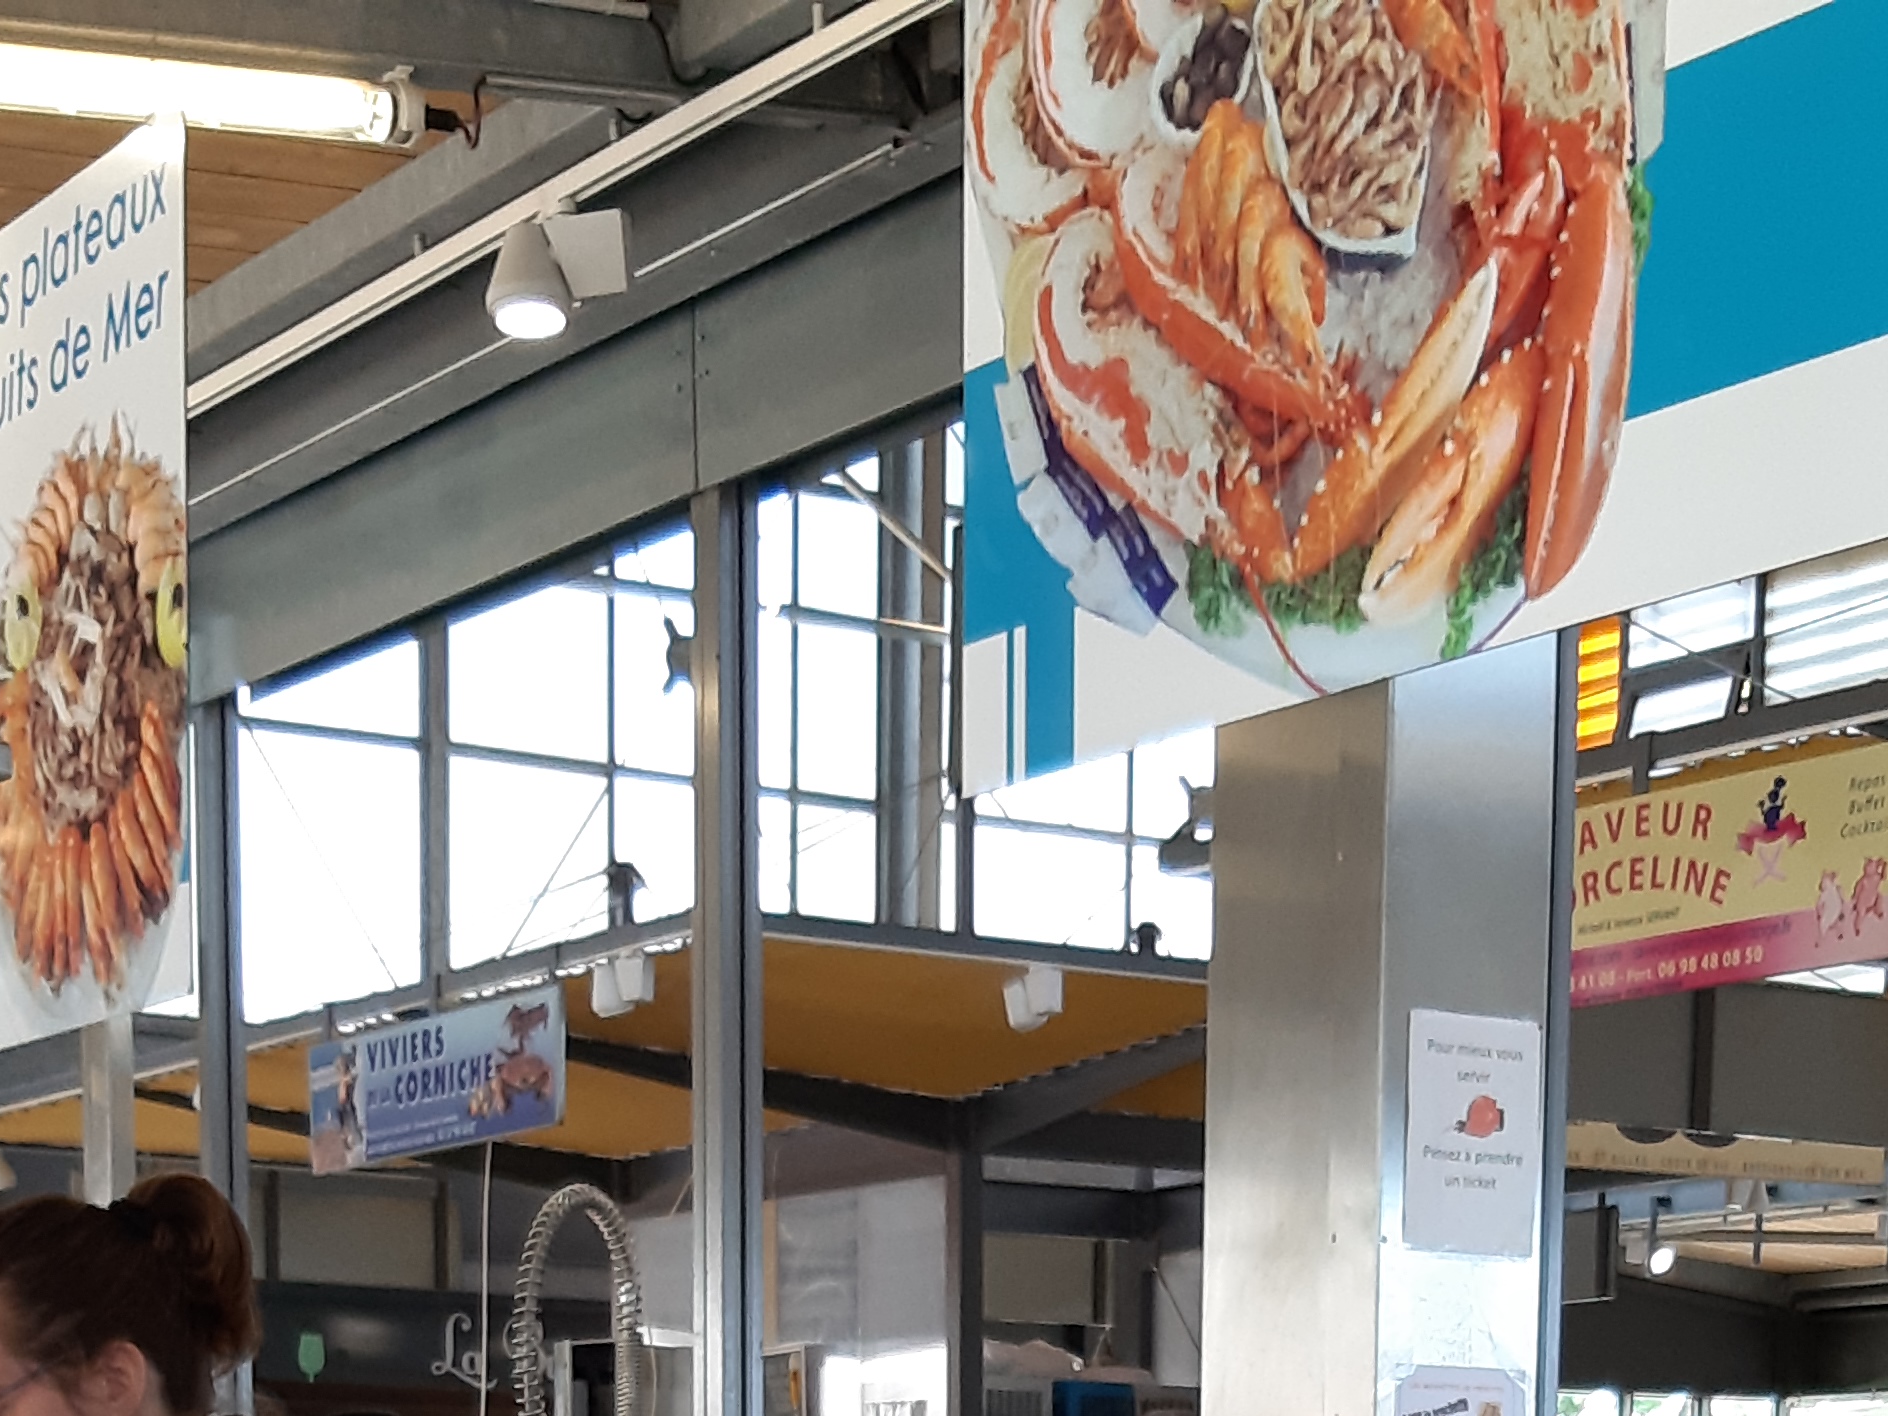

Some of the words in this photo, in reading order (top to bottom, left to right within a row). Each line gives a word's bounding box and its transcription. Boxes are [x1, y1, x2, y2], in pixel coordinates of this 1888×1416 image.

[21, 161, 166, 329] plateaux
[50, 317, 92, 394] de
[103, 270, 170, 364] Mer
[1578, 801, 1714, 856] AVEUR
[1573, 854, 1732, 906] RCELINE
[367, 1025, 445, 1072] VIVIERS
[395, 1052, 493, 1106] CORNICHE
